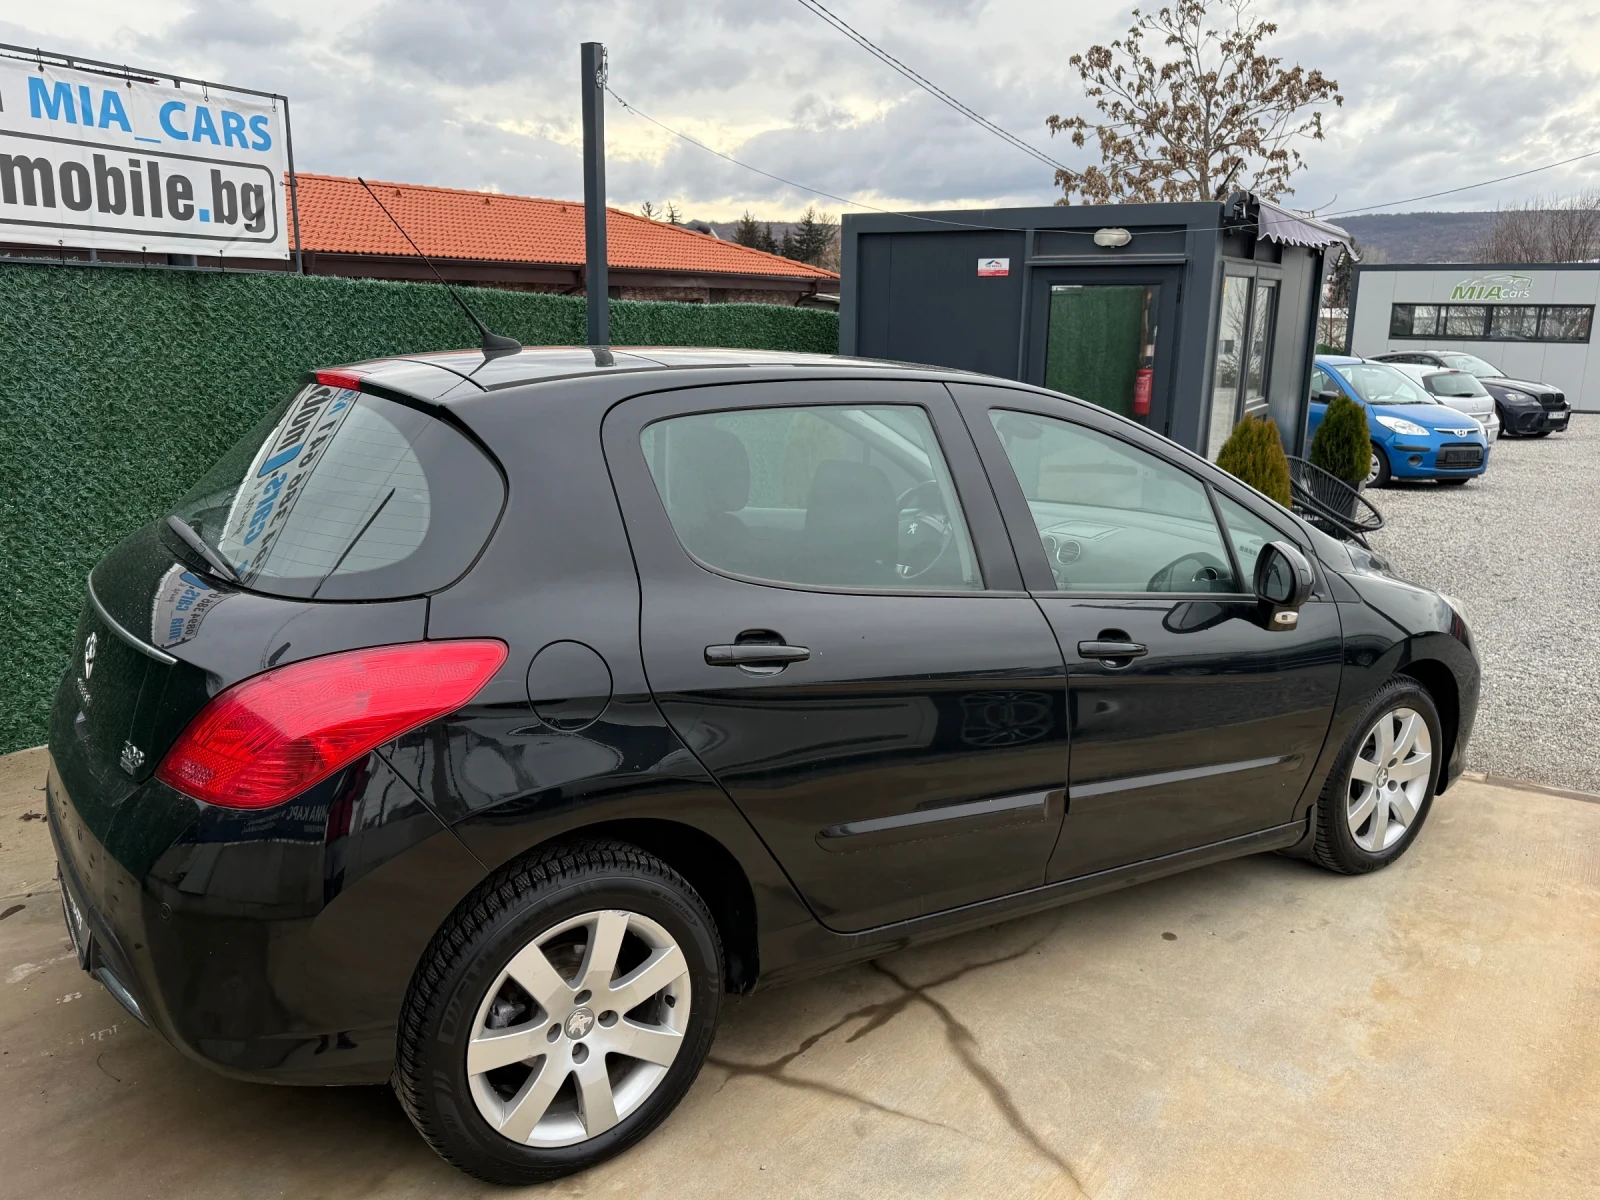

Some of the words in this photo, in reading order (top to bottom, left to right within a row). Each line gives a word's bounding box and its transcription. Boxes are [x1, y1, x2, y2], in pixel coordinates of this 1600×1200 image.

[28, 76, 272, 152] MIA_CARS
[0, 153, 266, 233] mobile.bg
[1450, 286, 1502, 300] MIA
[1501, 289, 1530, 298] Cars
